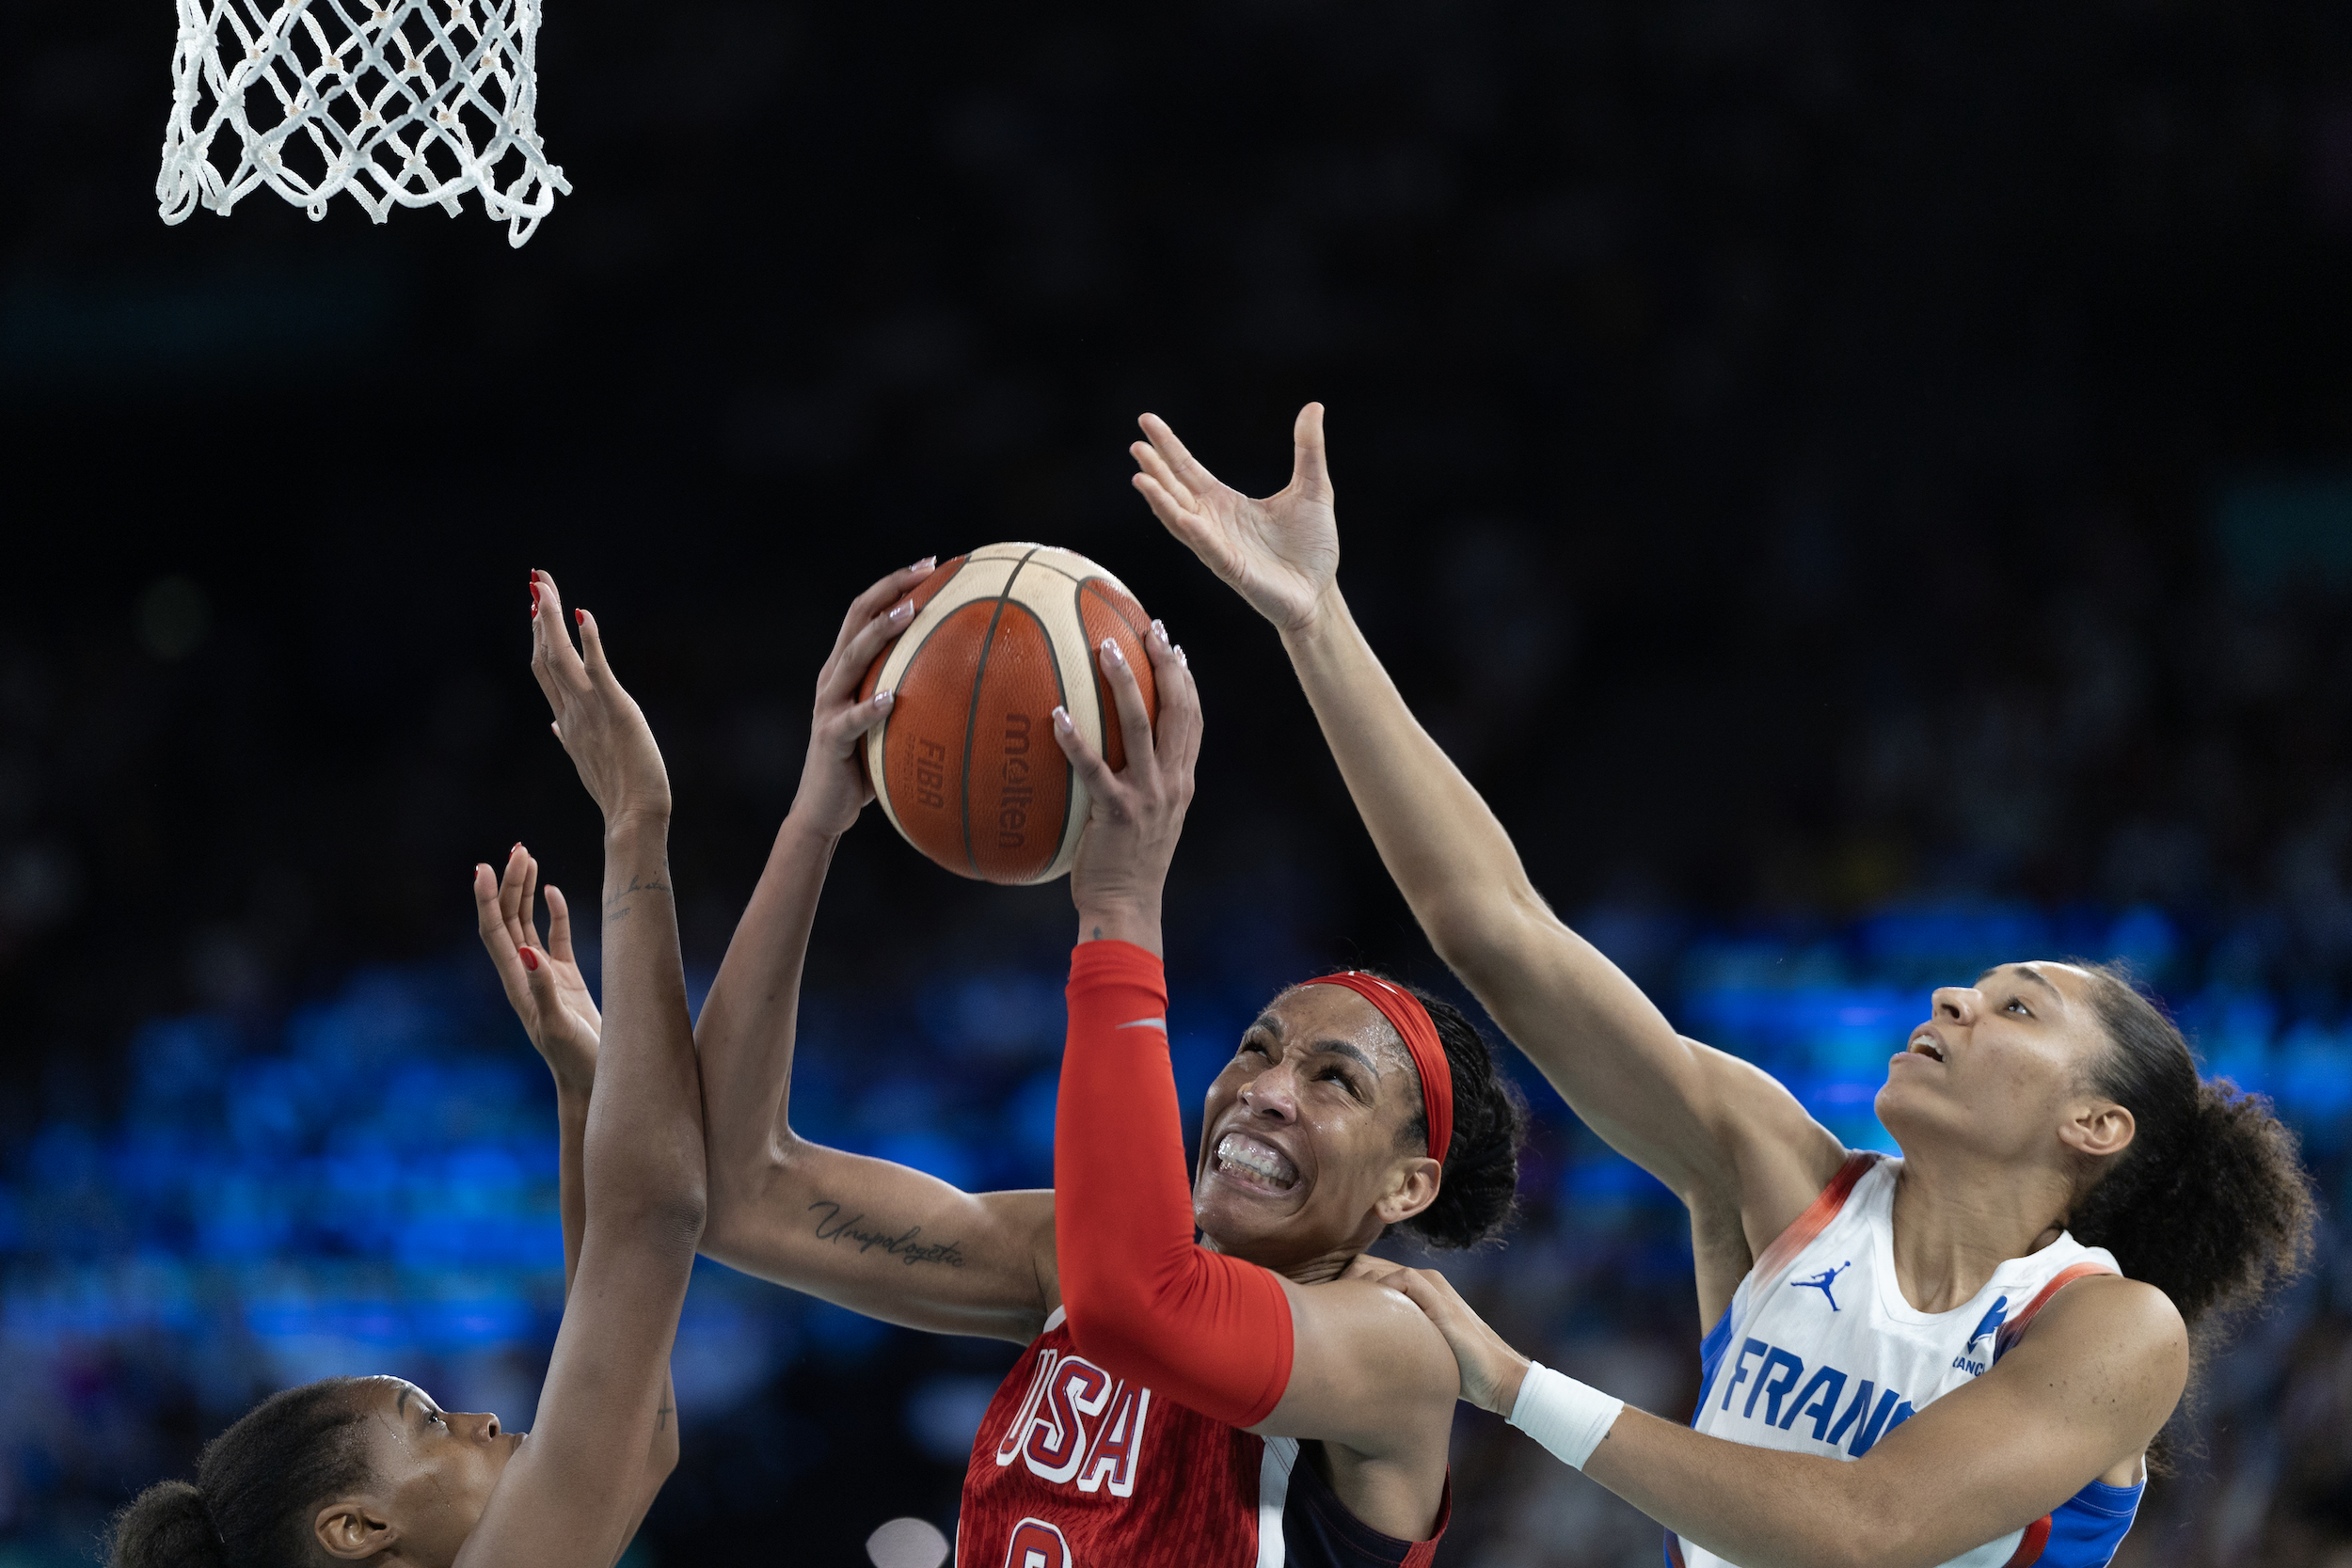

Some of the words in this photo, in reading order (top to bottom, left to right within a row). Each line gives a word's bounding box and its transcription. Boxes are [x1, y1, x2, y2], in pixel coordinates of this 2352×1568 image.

[917, 738, 946, 809] FIBA
[999, 714, 1033, 848] molten
[809, 1202, 964, 1267] Unapologetic
[996, 1349, 1151, 1498] USA
